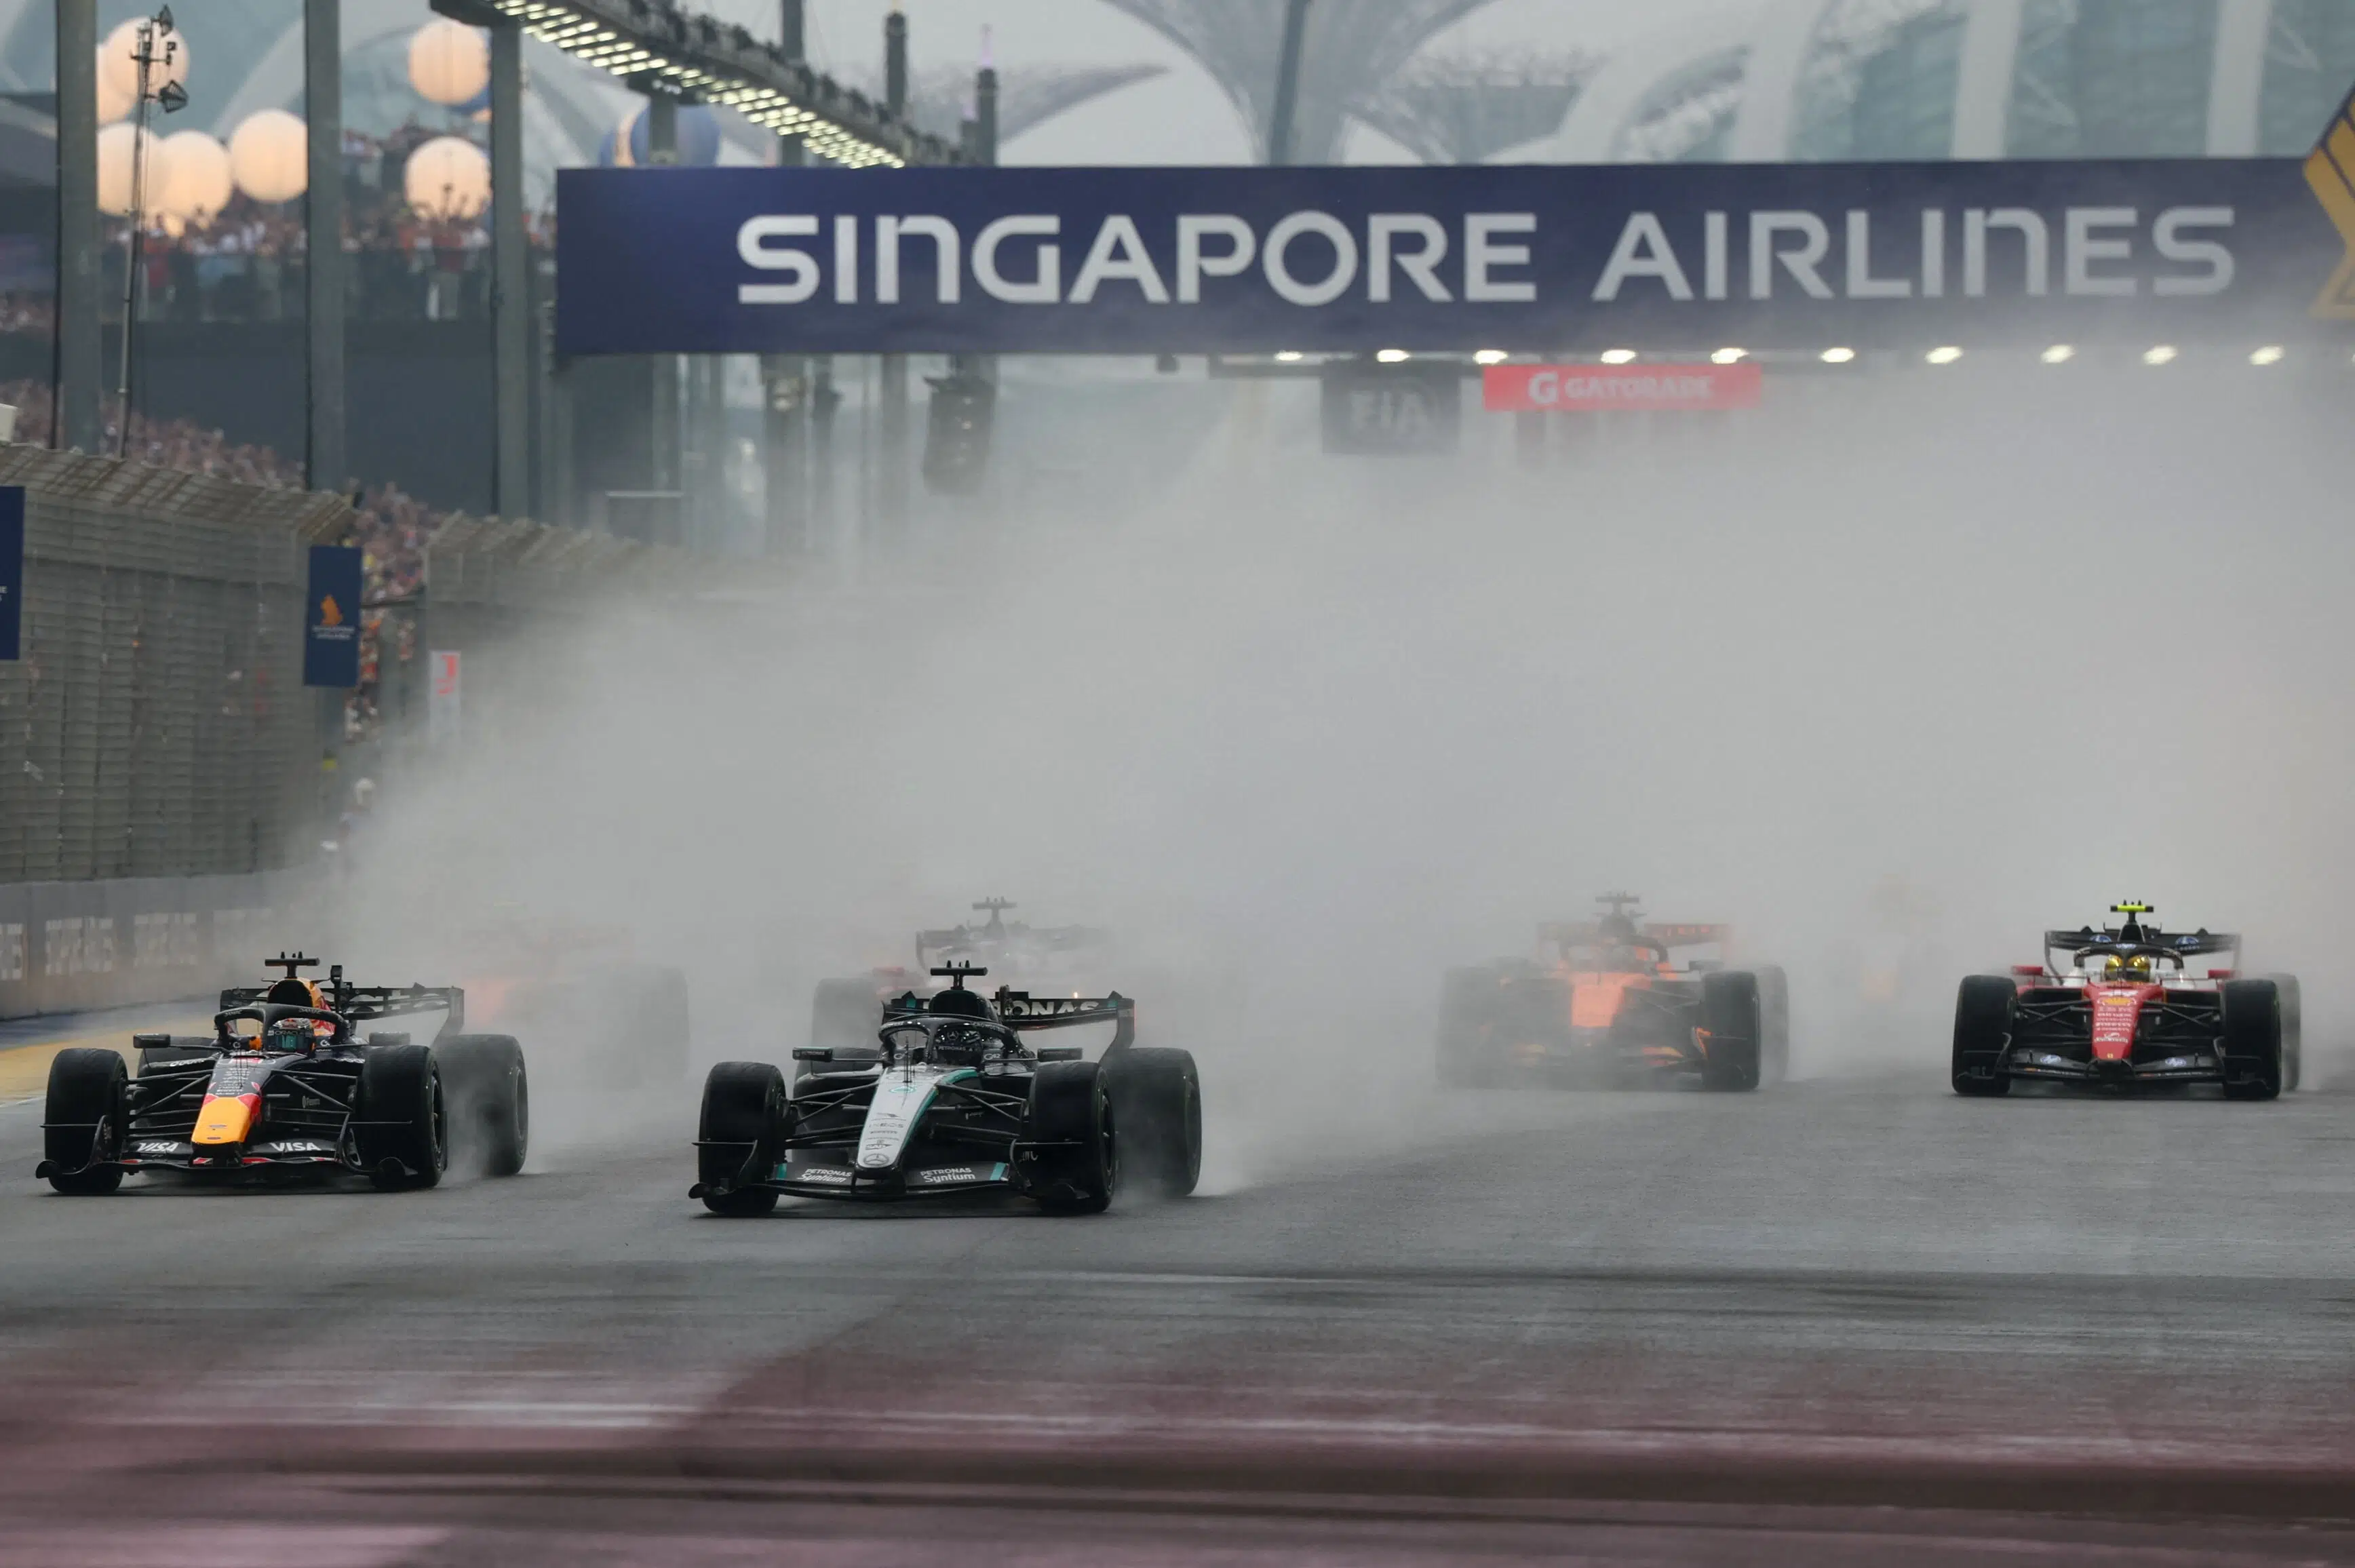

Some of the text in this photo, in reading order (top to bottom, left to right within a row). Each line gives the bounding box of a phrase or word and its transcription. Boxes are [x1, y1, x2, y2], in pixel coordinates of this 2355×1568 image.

[737, 208, 2234, 306] SINGAPORE AIRLINES
[1564, 375, 1715, 399] GATORADE
[137, 1142, 179, 1152] VISA
[269, 1142, 322, 1152] VISA
[797, 1173, 847, 1183] Syntium
[804, 1169, 853, 1177] PETRONAS
[923, 1173, 975, 1183] Syntium
